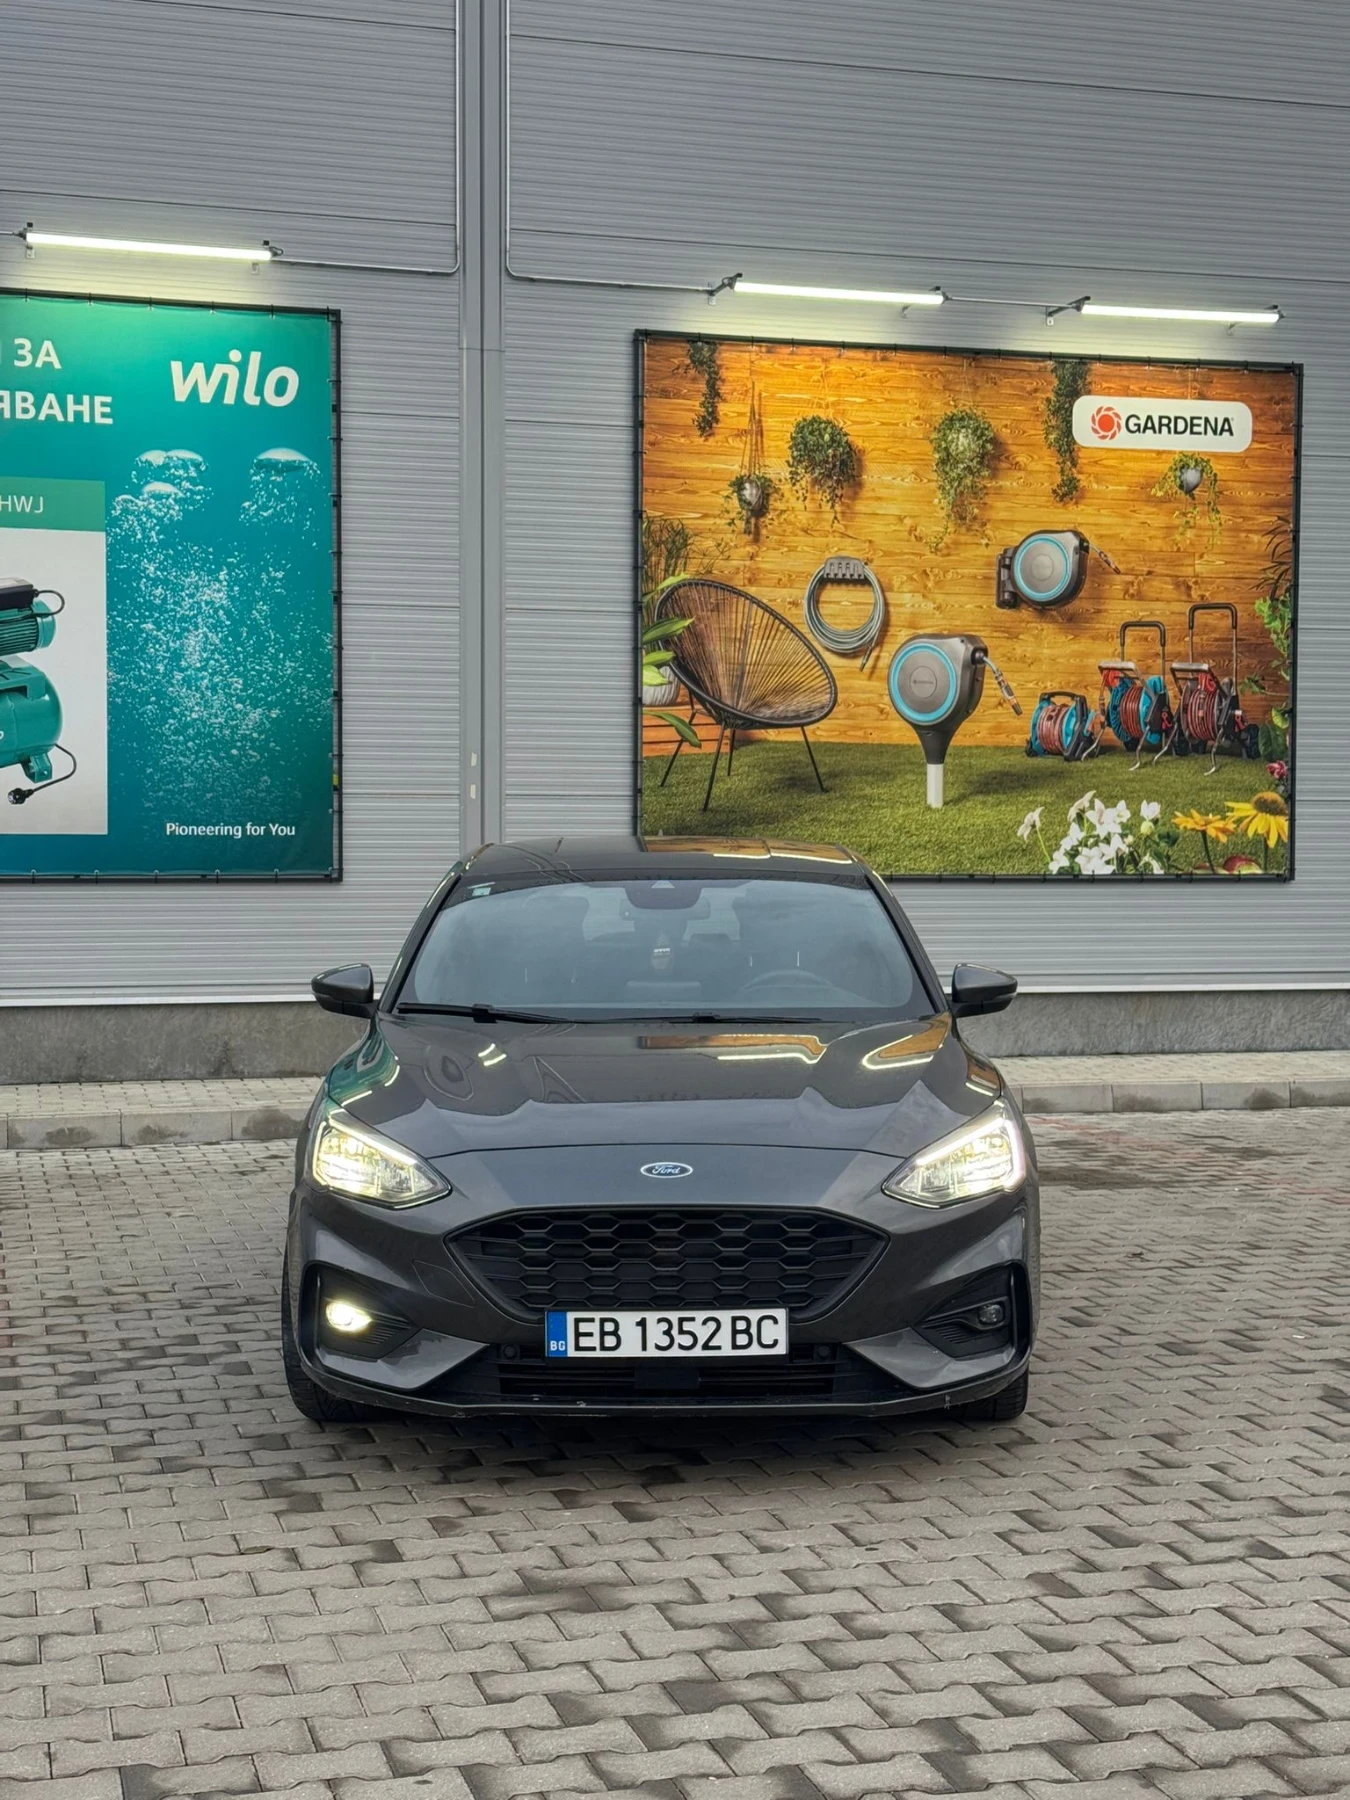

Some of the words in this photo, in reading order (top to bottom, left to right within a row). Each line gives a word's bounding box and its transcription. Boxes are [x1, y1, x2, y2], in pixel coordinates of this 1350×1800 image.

[13, 338, 62, 369] ЗА
[170, 349, 299, 407] wilo
[1125, 414, 1234, 436] GARDENA
[166, 822, 242, 839] Pioneering
[245, 822, 266, 836] for
[268, 823, 296, 836] You
[652, 1165, 681, 1174] Ford
[573, 1317, 622, 1352] EB
[635, 1316, 722, 1351] 1352
[731, 1315, 779, 1350] BC
[550, 1340, 566, 1351] BG
